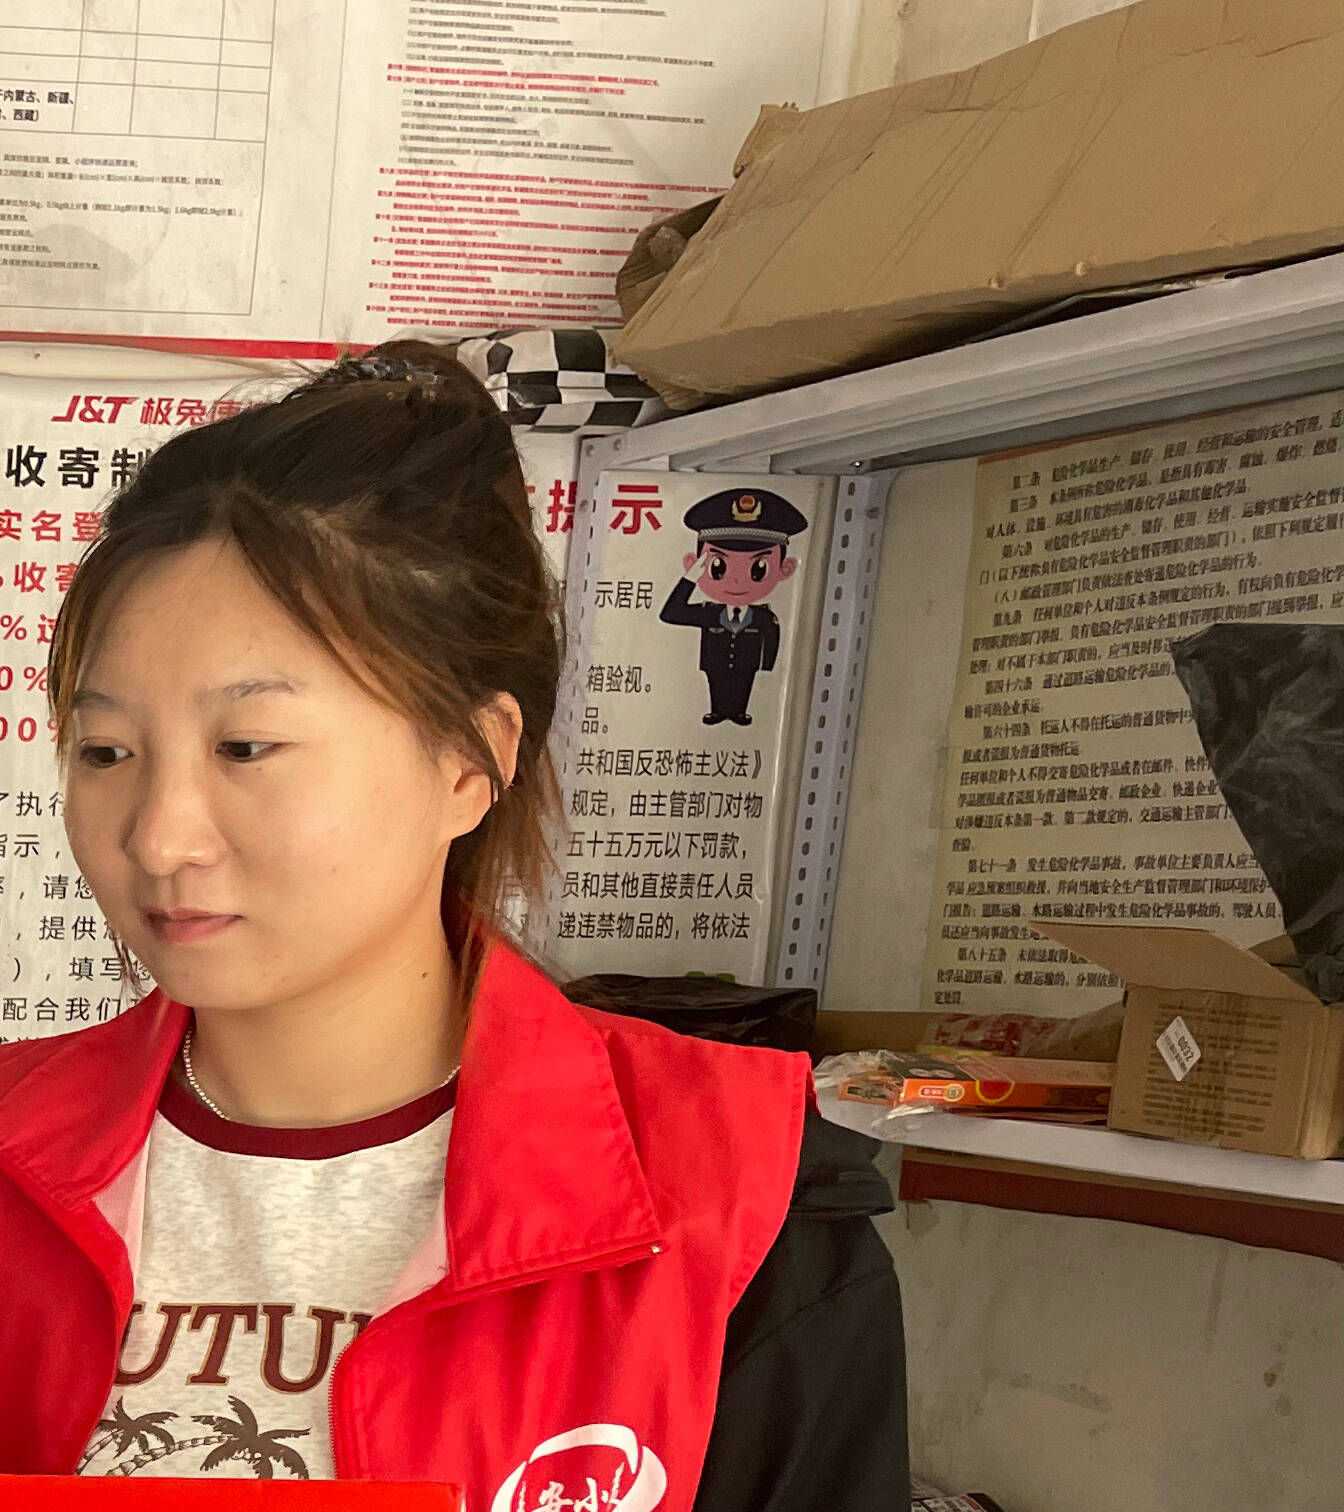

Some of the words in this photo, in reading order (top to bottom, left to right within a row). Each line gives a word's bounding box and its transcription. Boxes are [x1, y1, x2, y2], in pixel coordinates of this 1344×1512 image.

[50, 395, 140, 424] J&T
[595, 581, 653, 609] 示居民
[587, 665, 653, 694] 箱验视。
[576, 749, 763, 779] 共和国反恐怖主义法》
[570, 790, 763, 820] 规定，由主管部门对物
[566, 832, 748, 860] 五十五万元以下罚款，
[561, 871, 754, 901] 员和其他直接责任人员
[557, 911, 750, 941] 递违禁物品的，将依法
[113, 1302, 368, 1394] UTU
